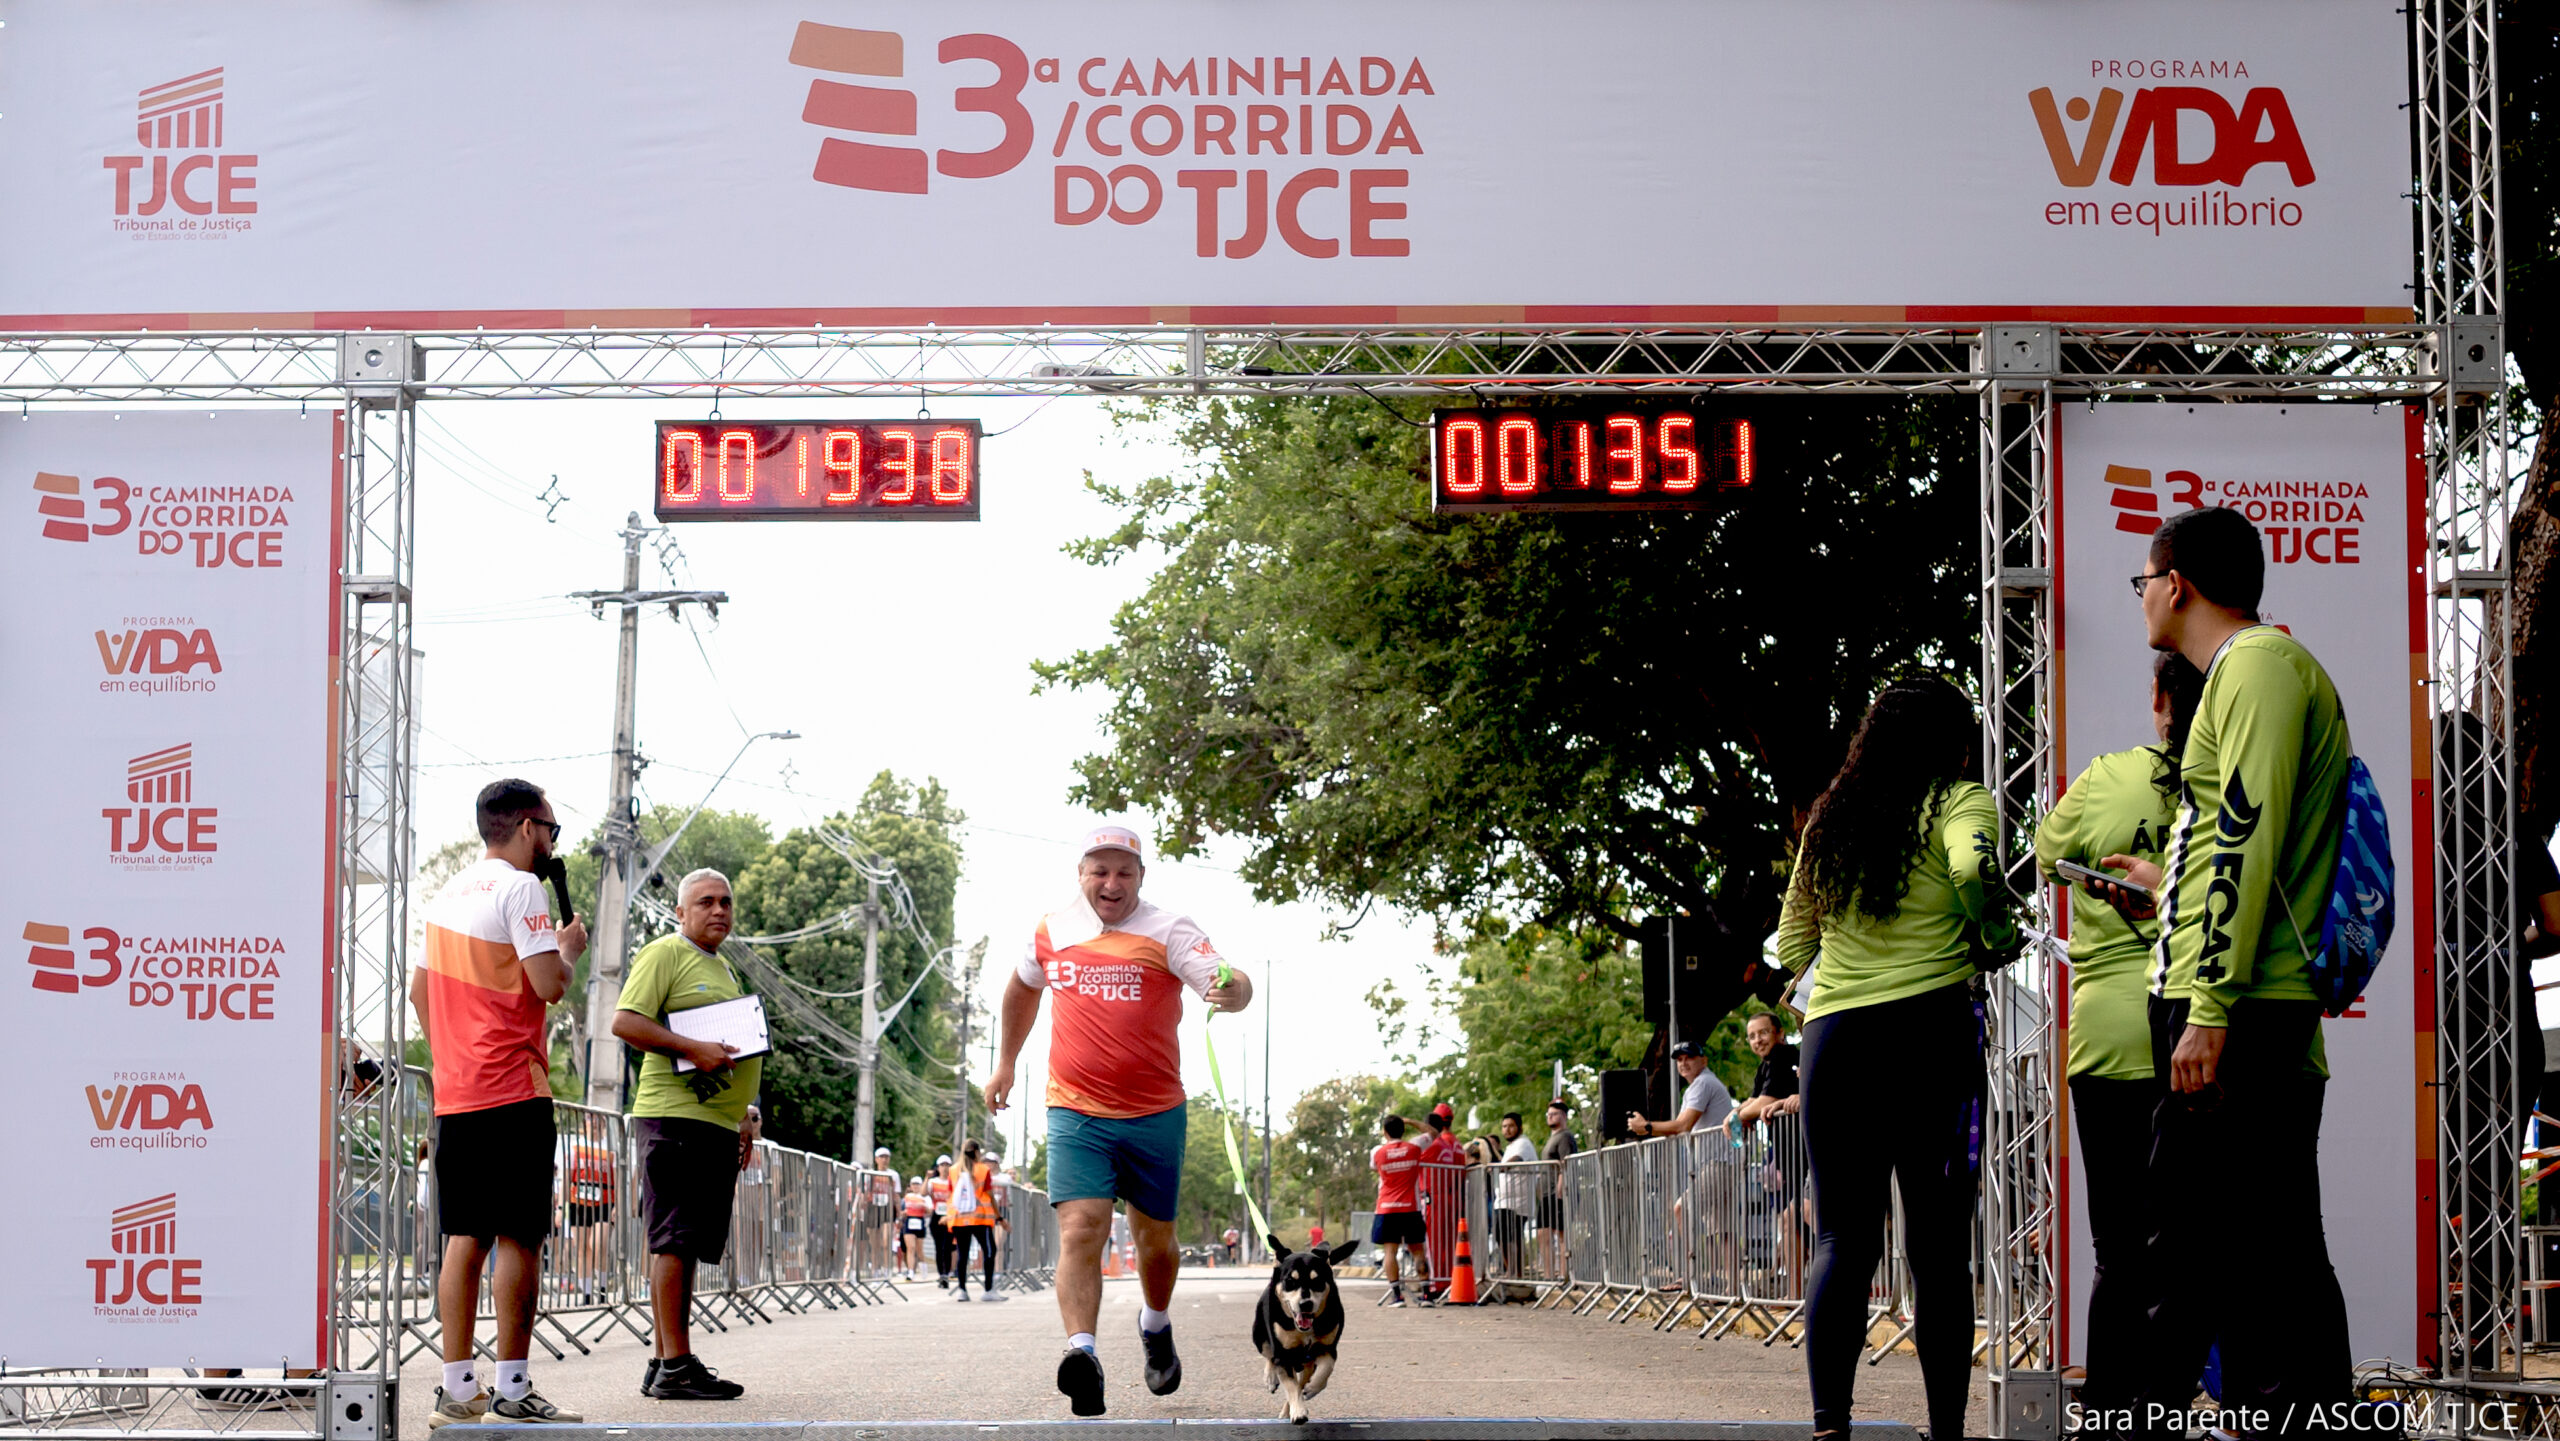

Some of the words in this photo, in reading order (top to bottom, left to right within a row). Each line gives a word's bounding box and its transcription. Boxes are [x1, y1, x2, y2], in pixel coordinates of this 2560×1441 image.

[2092, 60, 2248, 78] PROGRAMA
[937, 33, 1060, 179] 3ª
[1078, 56, 1435, 97] CAMINHADA
[1053, 101, 1424, 157] /CORRIDA
[2029, 87, 2316, 187] VIDA
[103, 155, 258, 216] TJCE
[1054, 164, 1163, 225] DO
[1177, 168, 1410, 259] TJCE
[2045, 202, 2099, 225] em
[2111, 191, 2302, 236] equilíbrio
[113, 218, 173, 231] Tribunal
[179, 218, 197, 230] de
[201, 218, 251, 233] Justiça
[148, 231, 181, 240] Estado
[2223, 481, 2369, 498] CAMINHADA
[92, 477, 143, 536] 3ª
[150, 486, 294, 503] CAMINHADA
[139, 504, 288, 527] /CORRIDA
[2218, 499, 2364, 523] ORRIDA
[139, 530, 183, 555] DO
[189, 531, 282, 568] TJCE
[2263, 527, 2359, 565] TJCE
[123, 617, 195, 626] PROGRAMA
[95, 629, 222, 675] VIDA
[100, 681, 124, 692] em
[129, 675, 215, 696] equilíbrio
[102, 808, 217, 853] TJCE
[110, 855, 154, 864] Tribunal
[158, 855, 172, 864] de
[176, 855, 213, 866] Justiça
[82, 927, 133, 988] 3ª
[140, 937, 285, 954] CAMINHADA
[129, 955, 280, 978] /CORRIDA
[1083, 964, 1145, 974] CAMINHADA
[1079, 973, 1143, 984] /CORRIDA
[129, 982, 174, 1007] DO
[180, 983, 274, 1020] TJCE
[1079, 984, 1099, 996] DO
[1100, 984, 1142, 1001] TJCE
[114, 1072, 185, 1081] PROGRAMA
[85, 1084, 213, 1130] VIDA
[90, 1137, 115, 1148] em
[120, 1132, 207, 1152] equilíbrio
[86, 1259, 202, 1305] TJCE
[94, 1306, 139, 1316] Tribunal
[143, 1307, 156, 1316] de
[160, 1307, 197, 1318] Justiça
